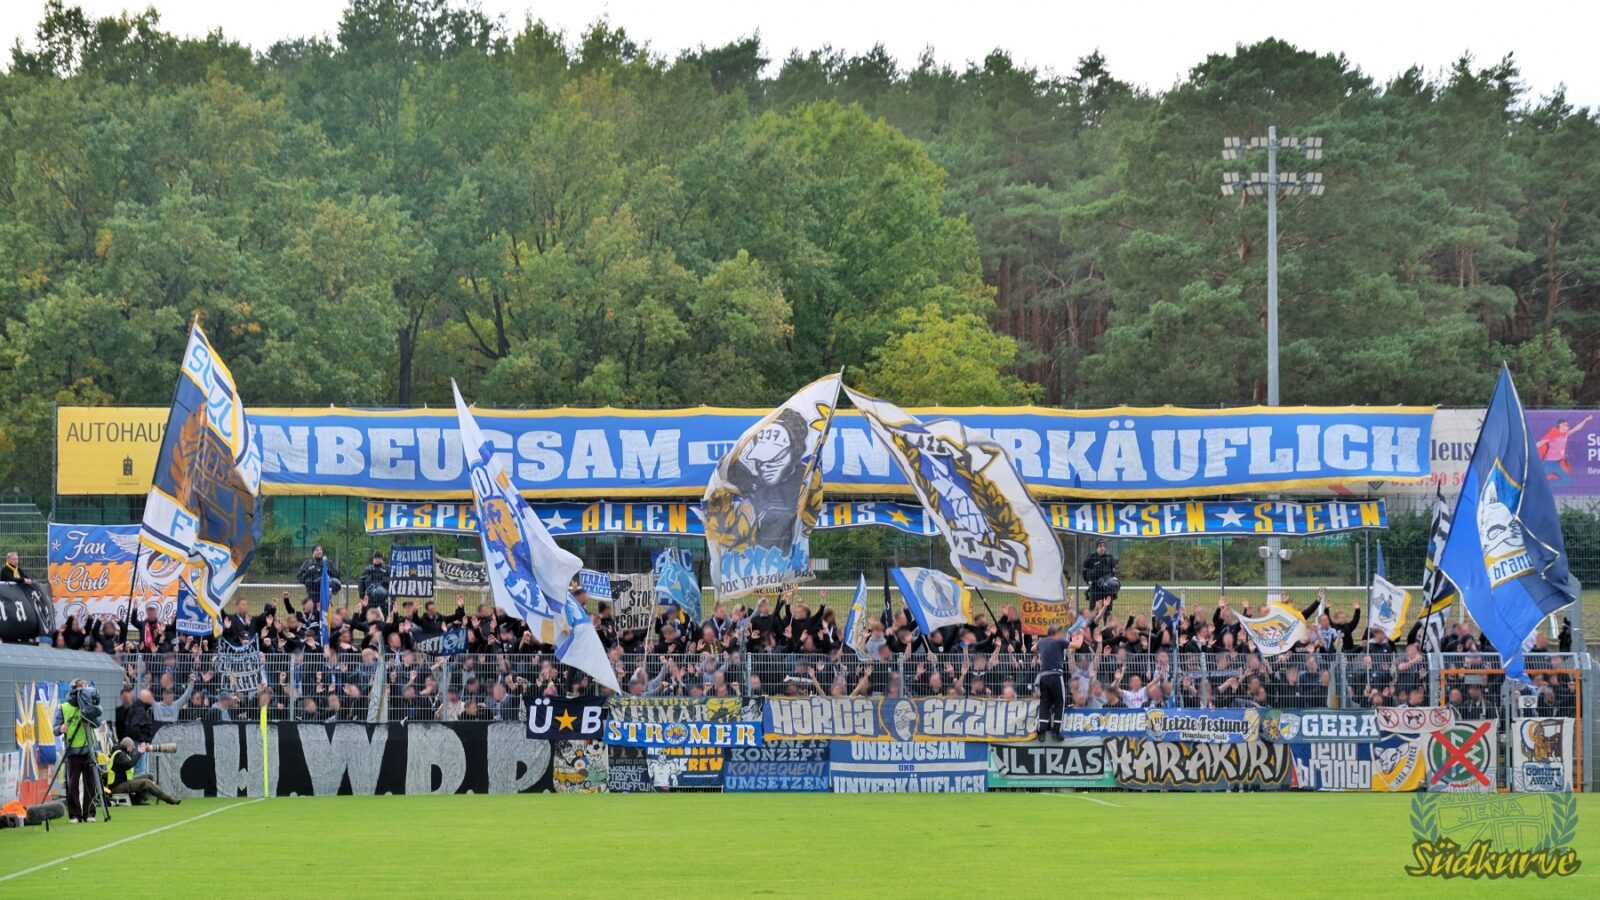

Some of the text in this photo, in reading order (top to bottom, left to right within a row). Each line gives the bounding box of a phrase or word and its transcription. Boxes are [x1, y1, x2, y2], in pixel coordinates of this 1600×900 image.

[66, 422, 167, 442] AUTOHAU
[250, 425, 680, 481] NBEUGSAM
[1431, 439, 1477, 461] leus
[366, 502, 477, 531] RESPE
[582, 503, 687, 532] ALLEN
[1050, 502, 1206, 535] RAUSSEN
[65, 530, 107, 561] Fan
[62, 566, 109, 592] Club
[390, 563, 433, 578] FÜR DIE
[441, 562, 479, 579] Ultras
[389, 579, 433, 596] KURVE
[1024, 616, 1068, 626] RASSISMU
[580, 705, 602, 733] B
[609, 704, 710, 723] WEIMAR
[1161, 716, 1249, 734] Letzte Festung
[1302, 713, 1379, 736] GERA
[731, 748, 825, 762] KONZEPT
[852, 741, 965, 761] UNBEUGSAM
[990, 746, 1103, 775] ULTRAS
[1107, 738, 1289, 781] HARAKIRI
[727, 762, 825, 776] KONSEQUENT
[898, 762, 915, 771] UND
[725, 776, 829, 790] UMSETZEN
[833, 773, 985, 793] UNVERKÄUFLICH
